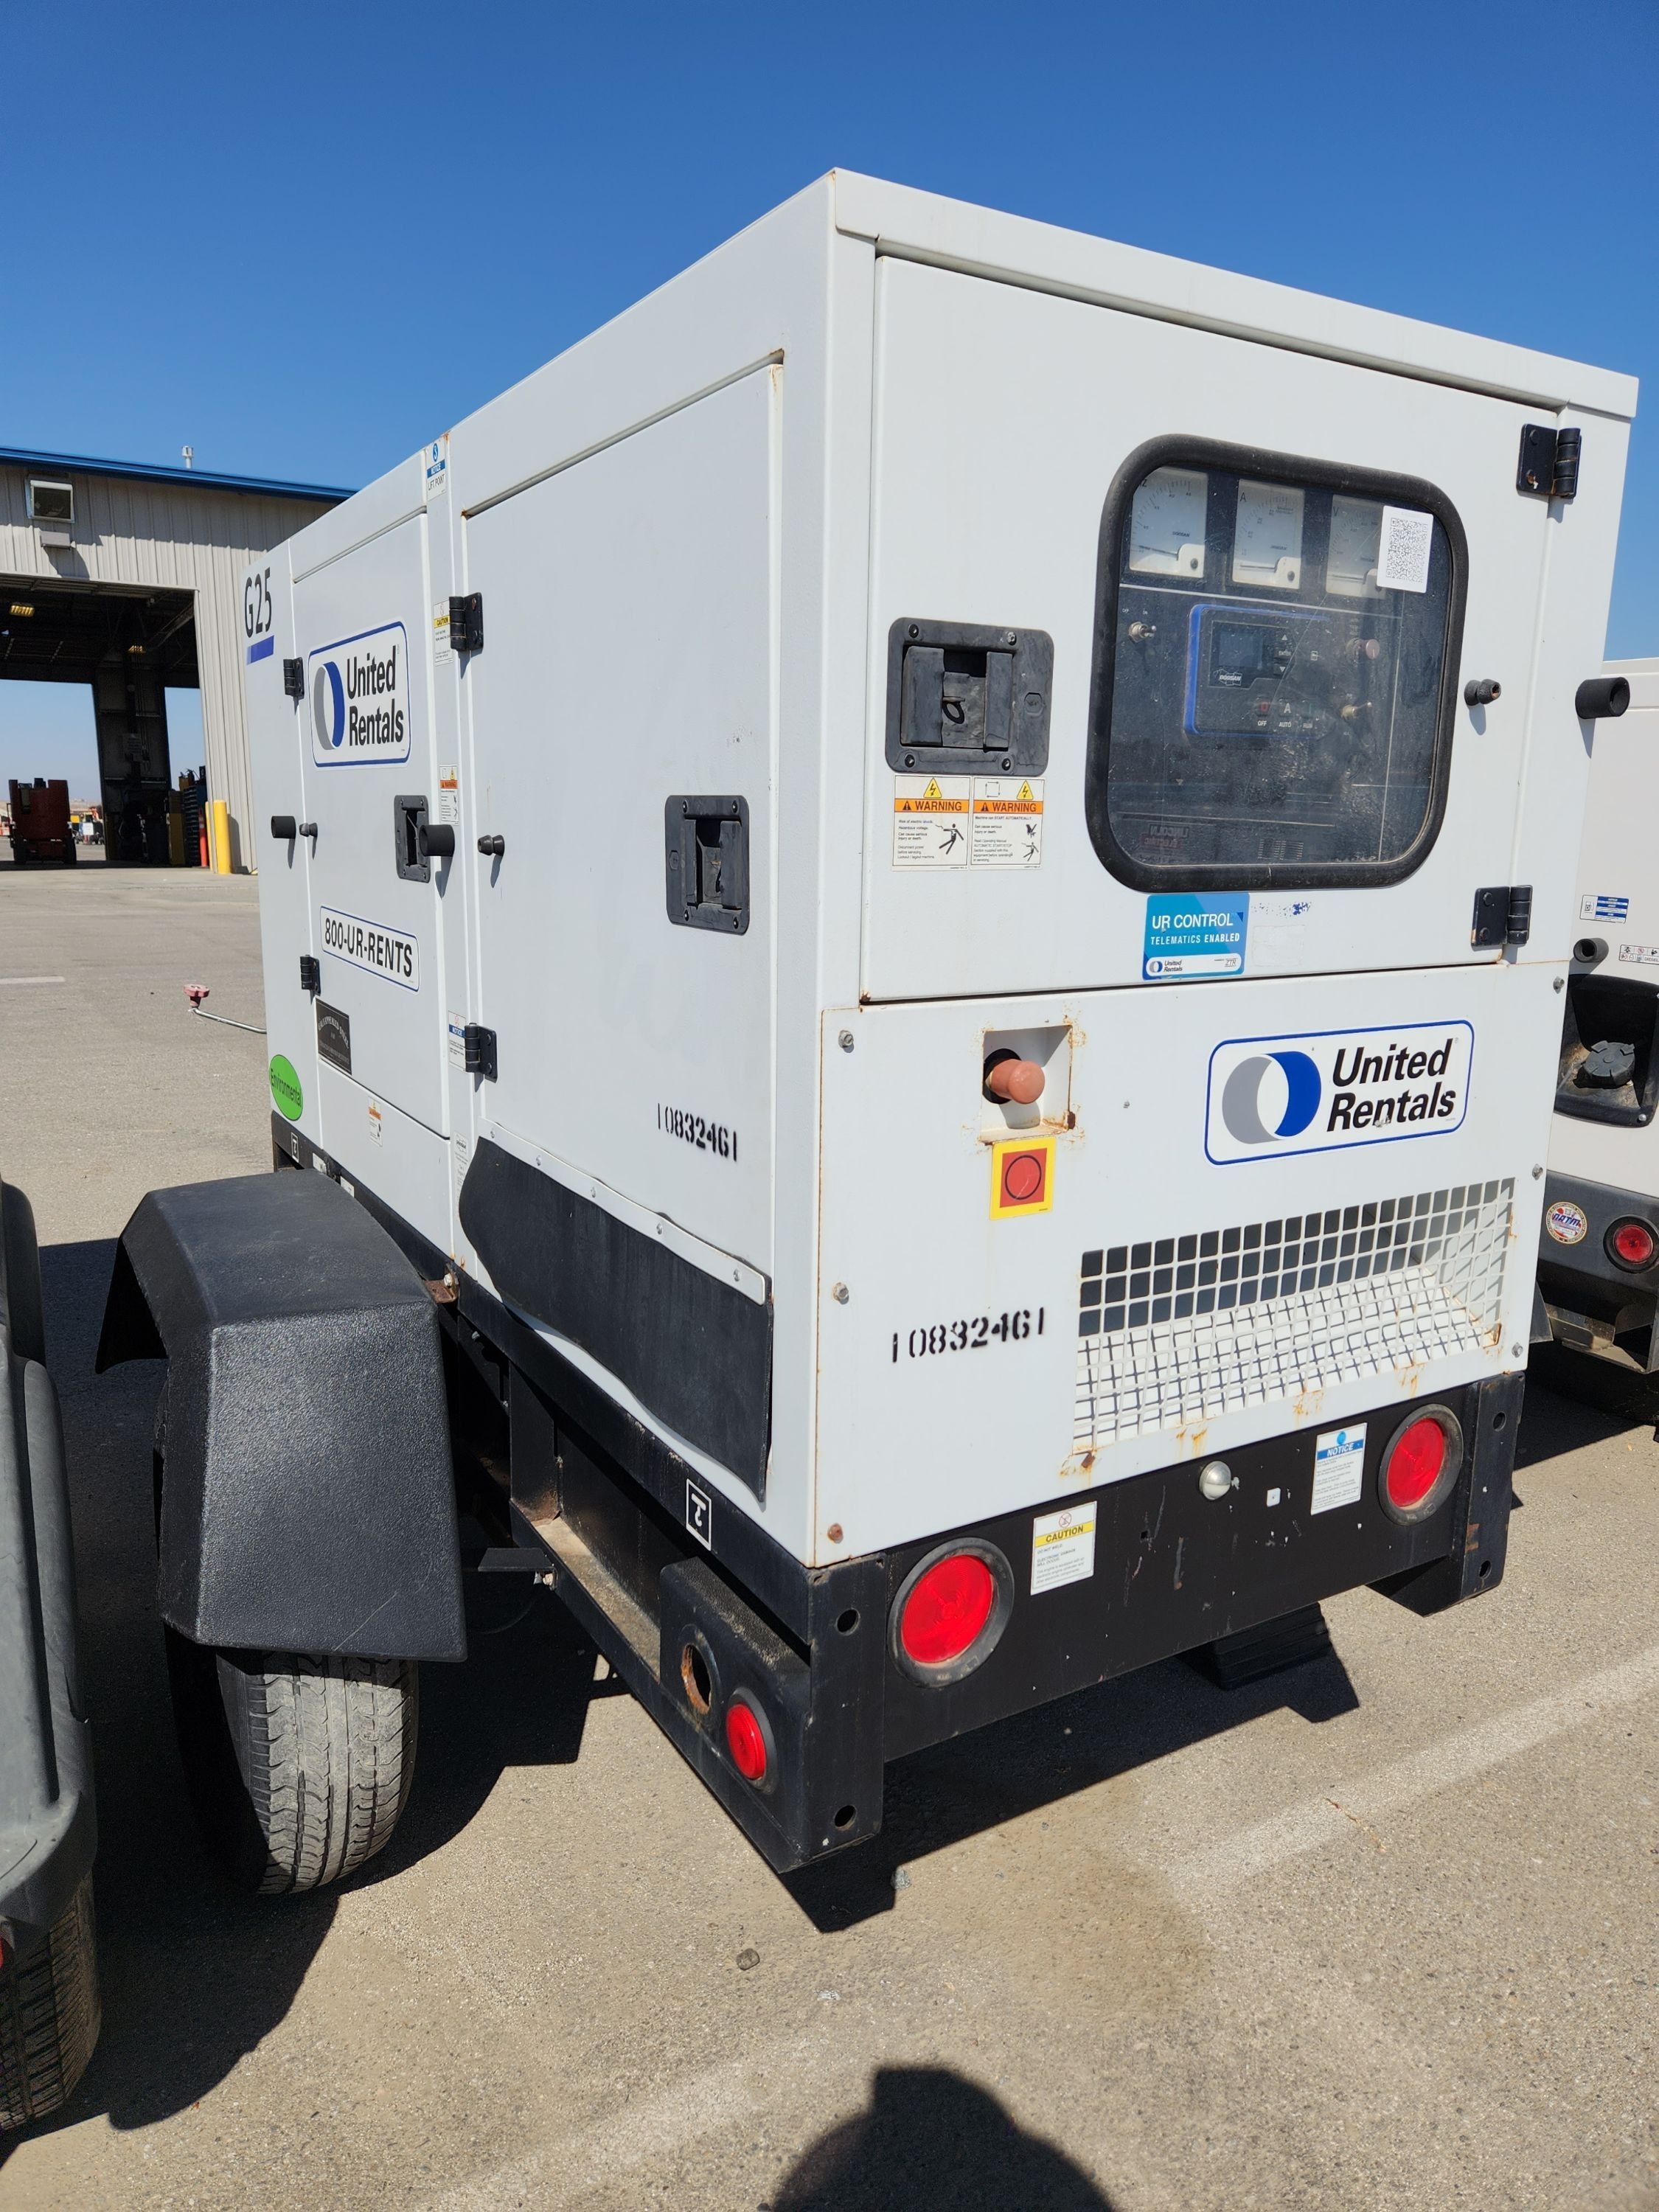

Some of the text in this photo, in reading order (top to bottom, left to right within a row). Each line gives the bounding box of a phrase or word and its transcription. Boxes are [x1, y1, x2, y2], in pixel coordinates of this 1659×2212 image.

[435, 474, 445, 486] POINT
[1239, 492, 1247, 502] A
[1333, 507, 1339, 516] V
[244, 566, 271, 638] G25
[437, 617, 448, 625] CAUTION
[347, 644, 396, 700] United
[349, 698, 404, 746] Rentals
[914, 801, 961, 811] WARNING
[992, 802, 1036, 812] WARNING
[1152, 914, 1233, 929] UR CONTROL
[325, 917, 412, 978] 800-UR-RENTS
[1150, 933, 1239, 945] TELEMATICS ENABLED
[1332, 1038, 1453, 1088] United
[271, 1068, 302, 1107] Environmental
[1326, 1082, 1455, 1132] Rentals
[658, 1102, 737, 1162] 10832461
[892, 1307, 1044, 1363] 10832461
[1327, 1442, 1354, 1457] NOTICE
[1046, 1525, 1083, 1543] CAUTION
